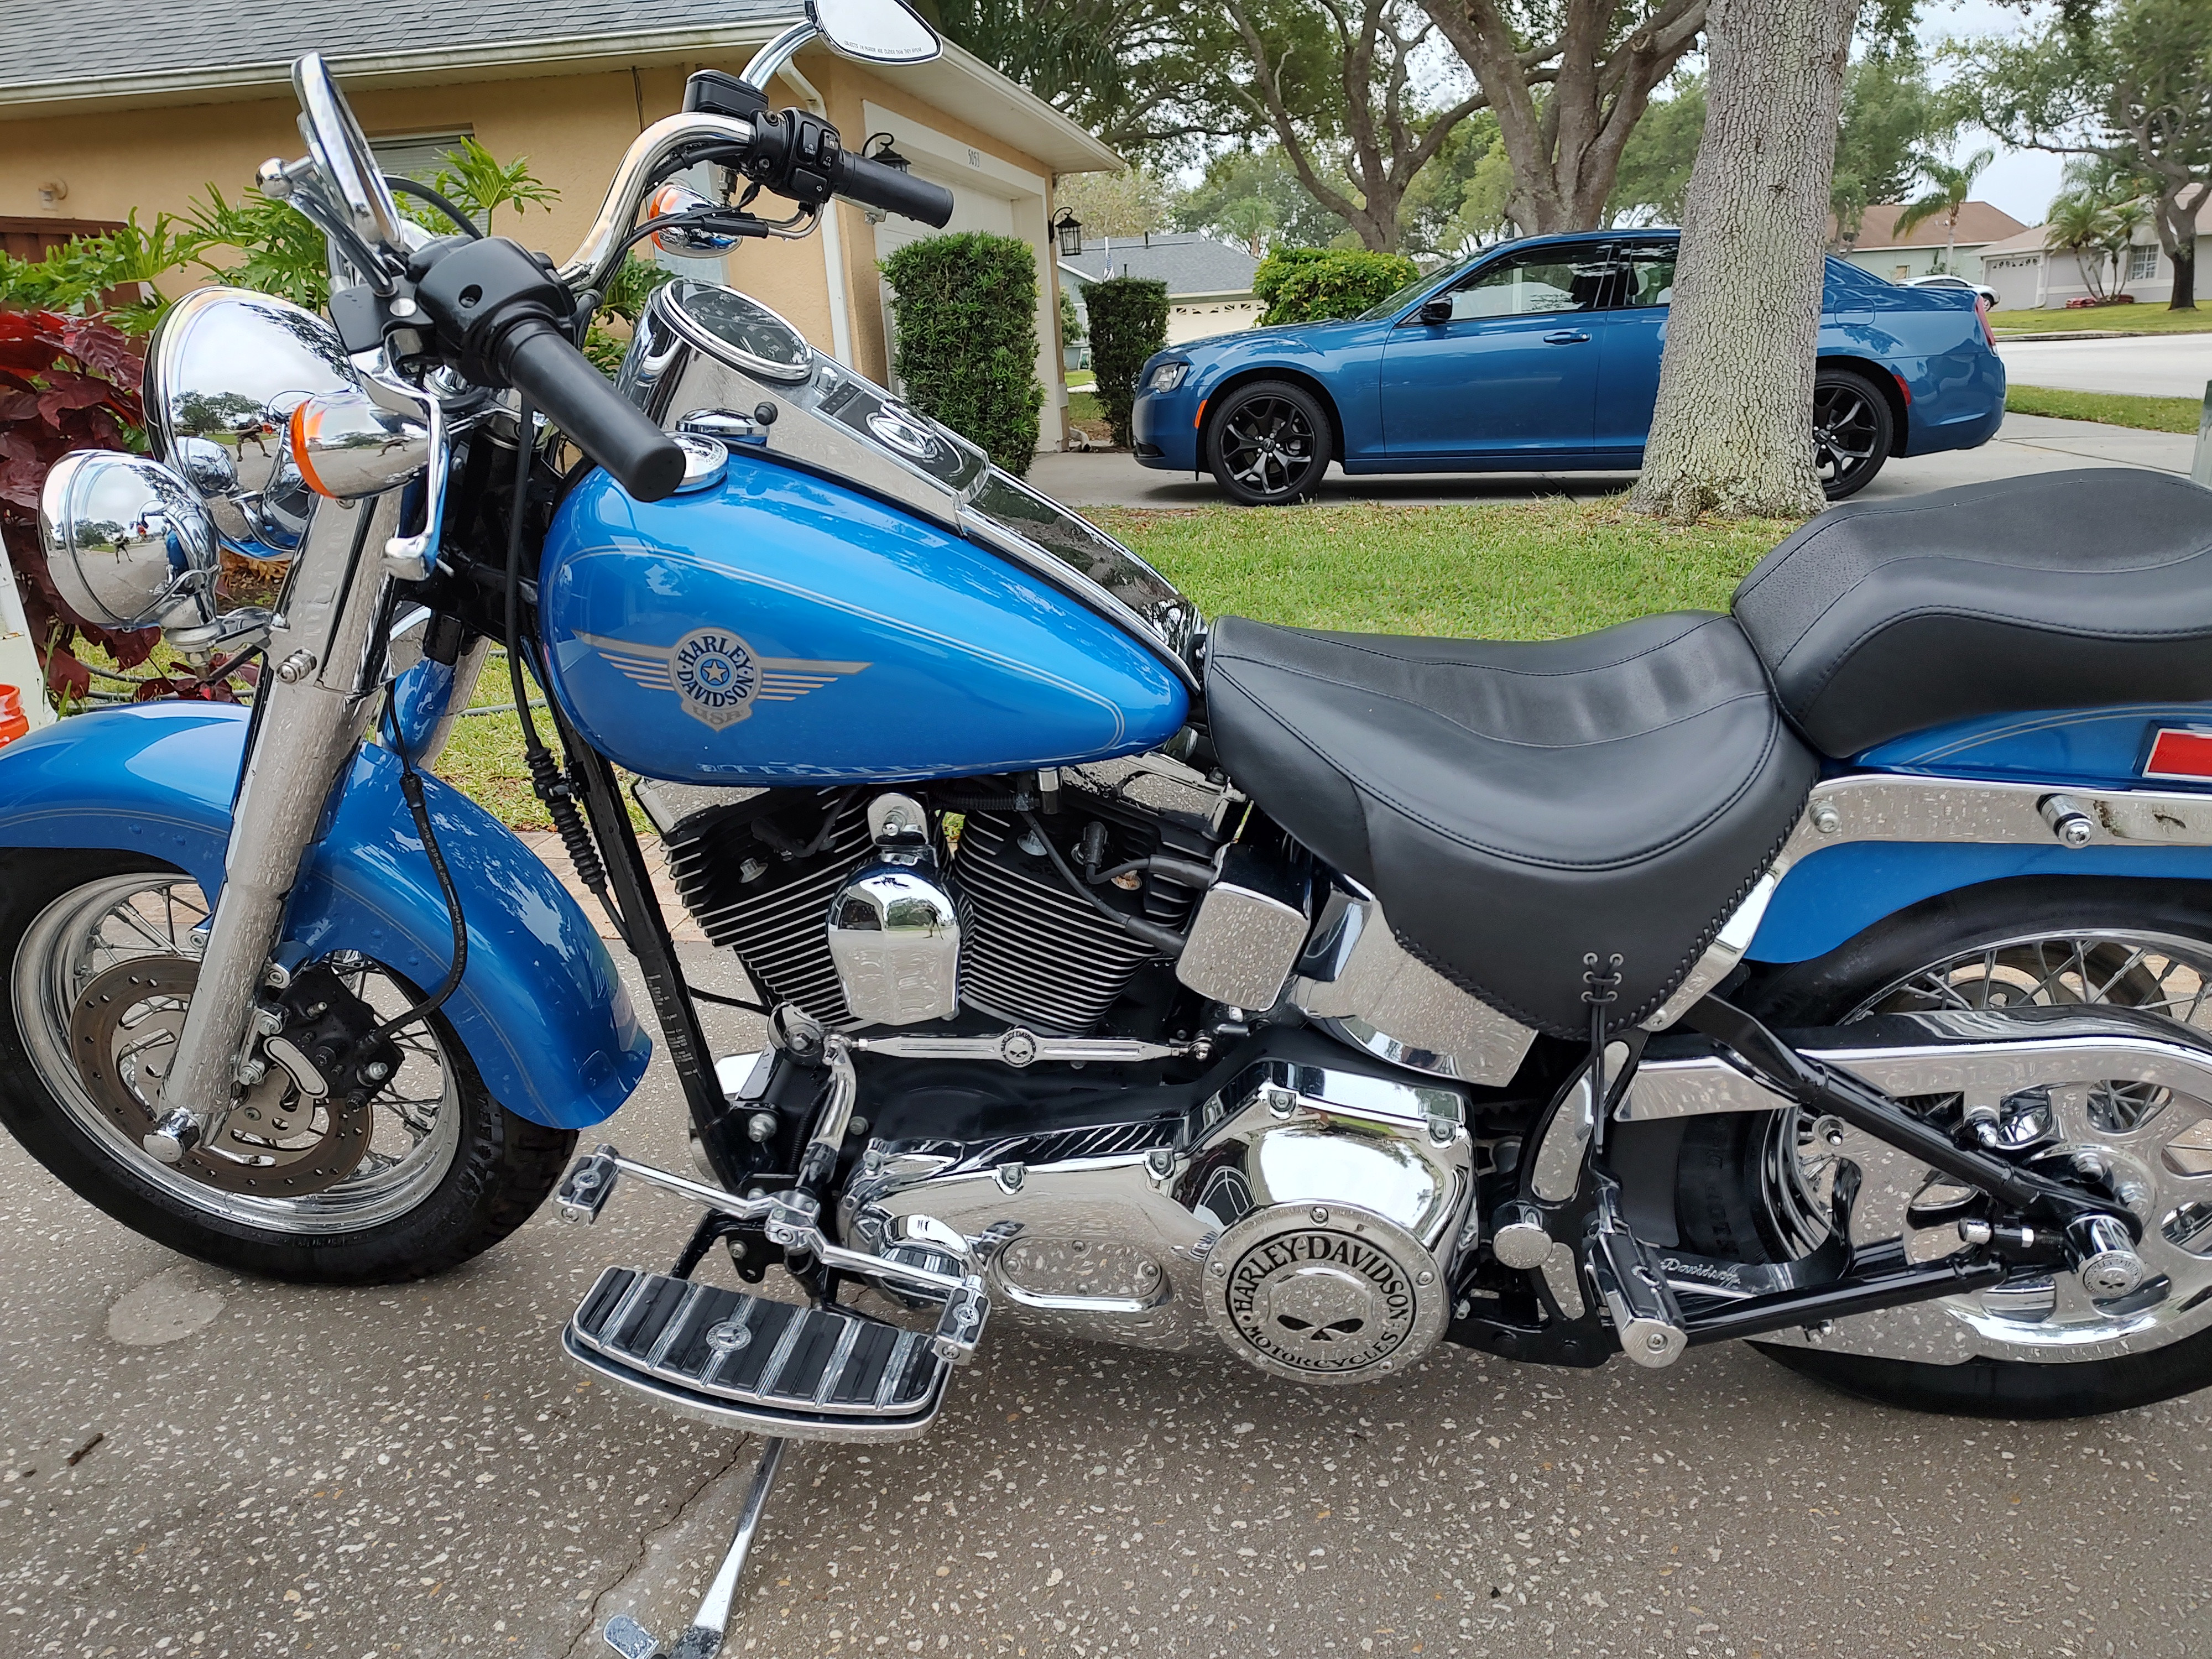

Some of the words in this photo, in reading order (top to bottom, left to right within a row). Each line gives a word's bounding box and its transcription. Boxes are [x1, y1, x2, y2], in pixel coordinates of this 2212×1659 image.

[844, 40, 858, 49] OBJECTS
[677, 635, 753, 672] HARLEY
[677, 669, 755, 708] DAVIDSON
[1244, 1326, 1399, 1369] MOTORCYCLES
